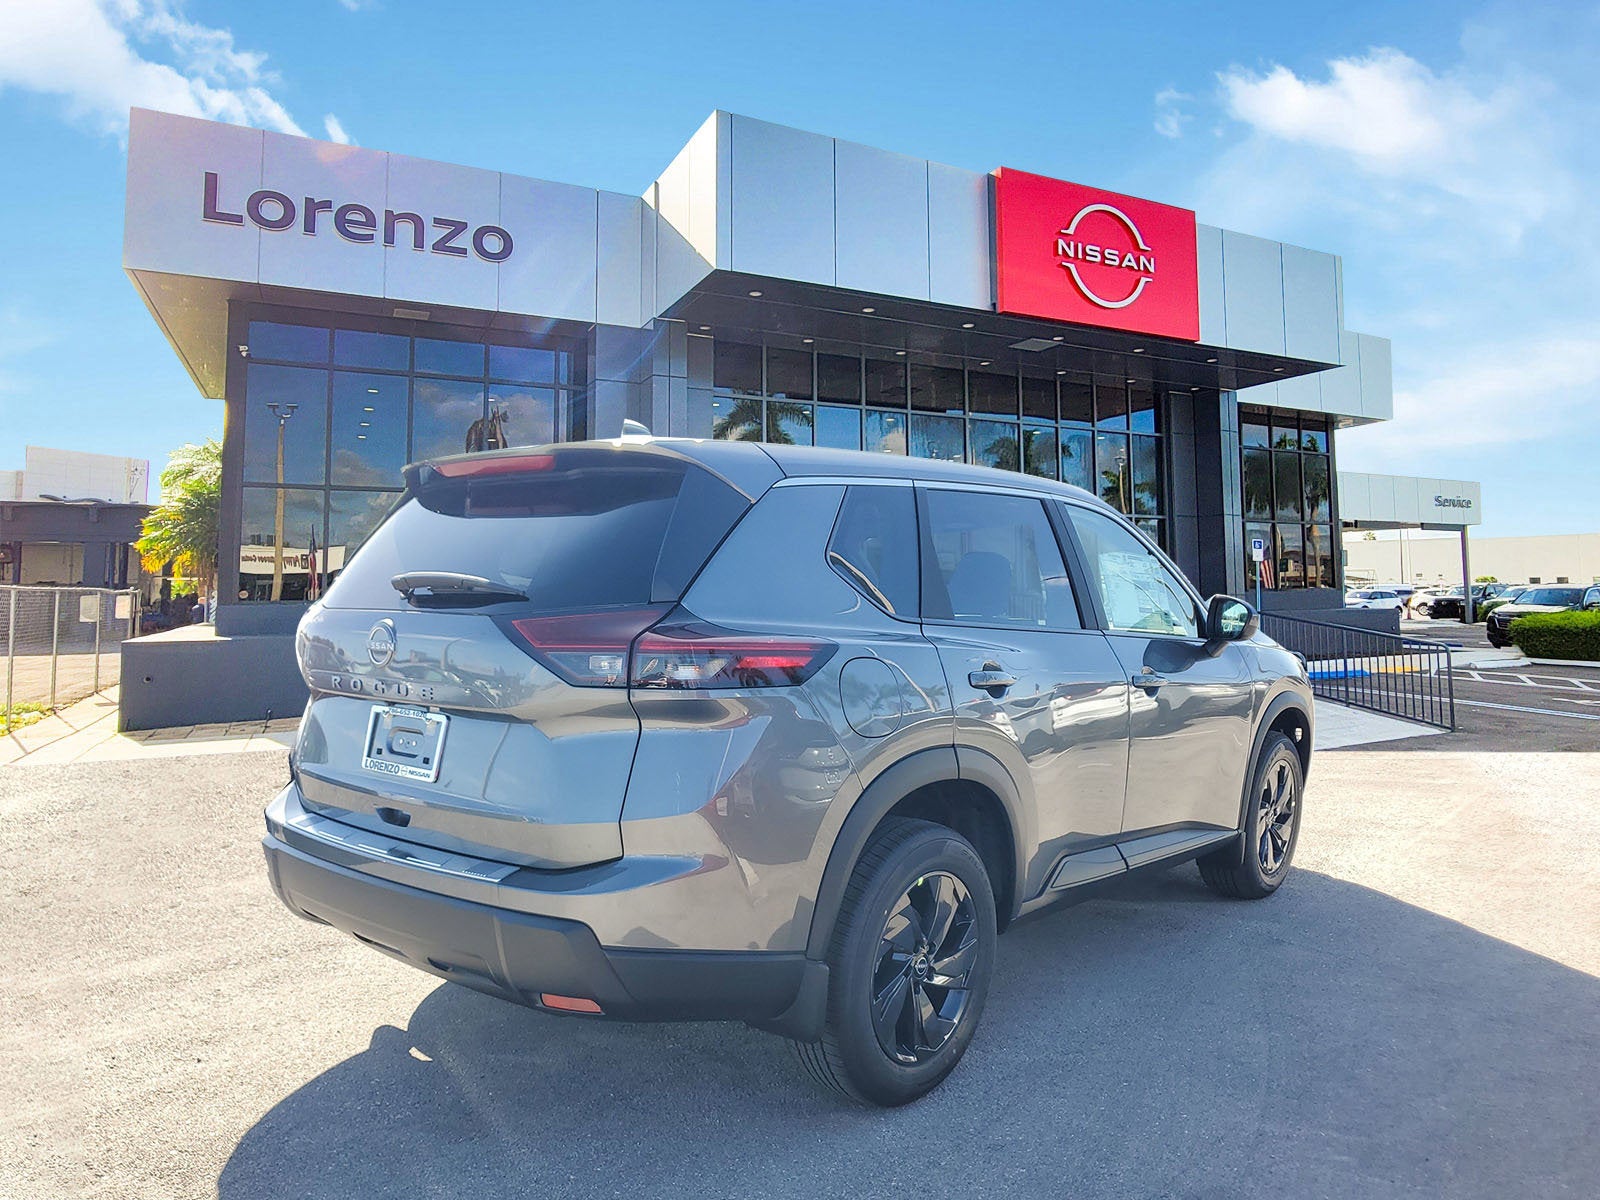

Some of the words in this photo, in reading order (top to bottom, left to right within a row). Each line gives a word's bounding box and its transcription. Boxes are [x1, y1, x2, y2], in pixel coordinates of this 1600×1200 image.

[203, 170, 514, 263] Lorenzo
[1057, 238, 1156, 273] NISSAN
[1434, 495, 1472, 508] Service
[331, 675, 435, 700] ROGUE
[365, 758, 400, 775] LORENZO
[408, 769, 431, 778] NISSAN
